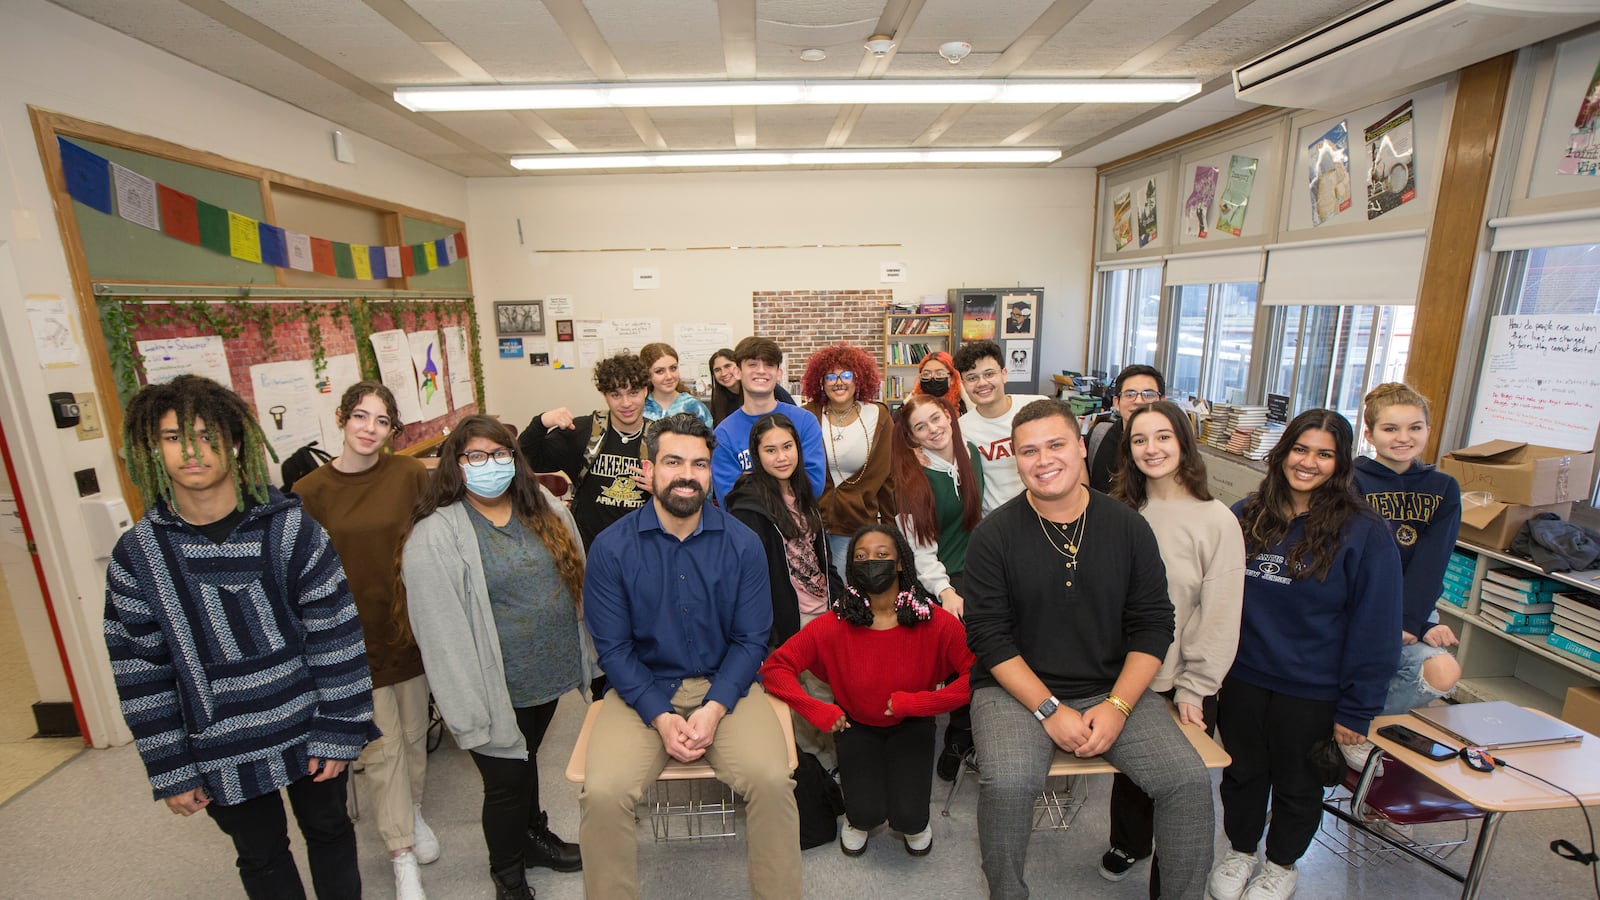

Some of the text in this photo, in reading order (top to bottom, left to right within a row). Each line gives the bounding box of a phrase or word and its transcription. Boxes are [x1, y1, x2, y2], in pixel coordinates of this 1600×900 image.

[1577, 160, 1600, 173] Vie
[1509, 318, 1522, 330] How
[1524, 319, 1533, 330] do
[1574, 323, 1597, 332] when
[596, 495, 646, 509] ARMY ROT
[1261, 573, 1293, 585] JERSEY
[1564, 642, 1592, 660] LITERATURE
